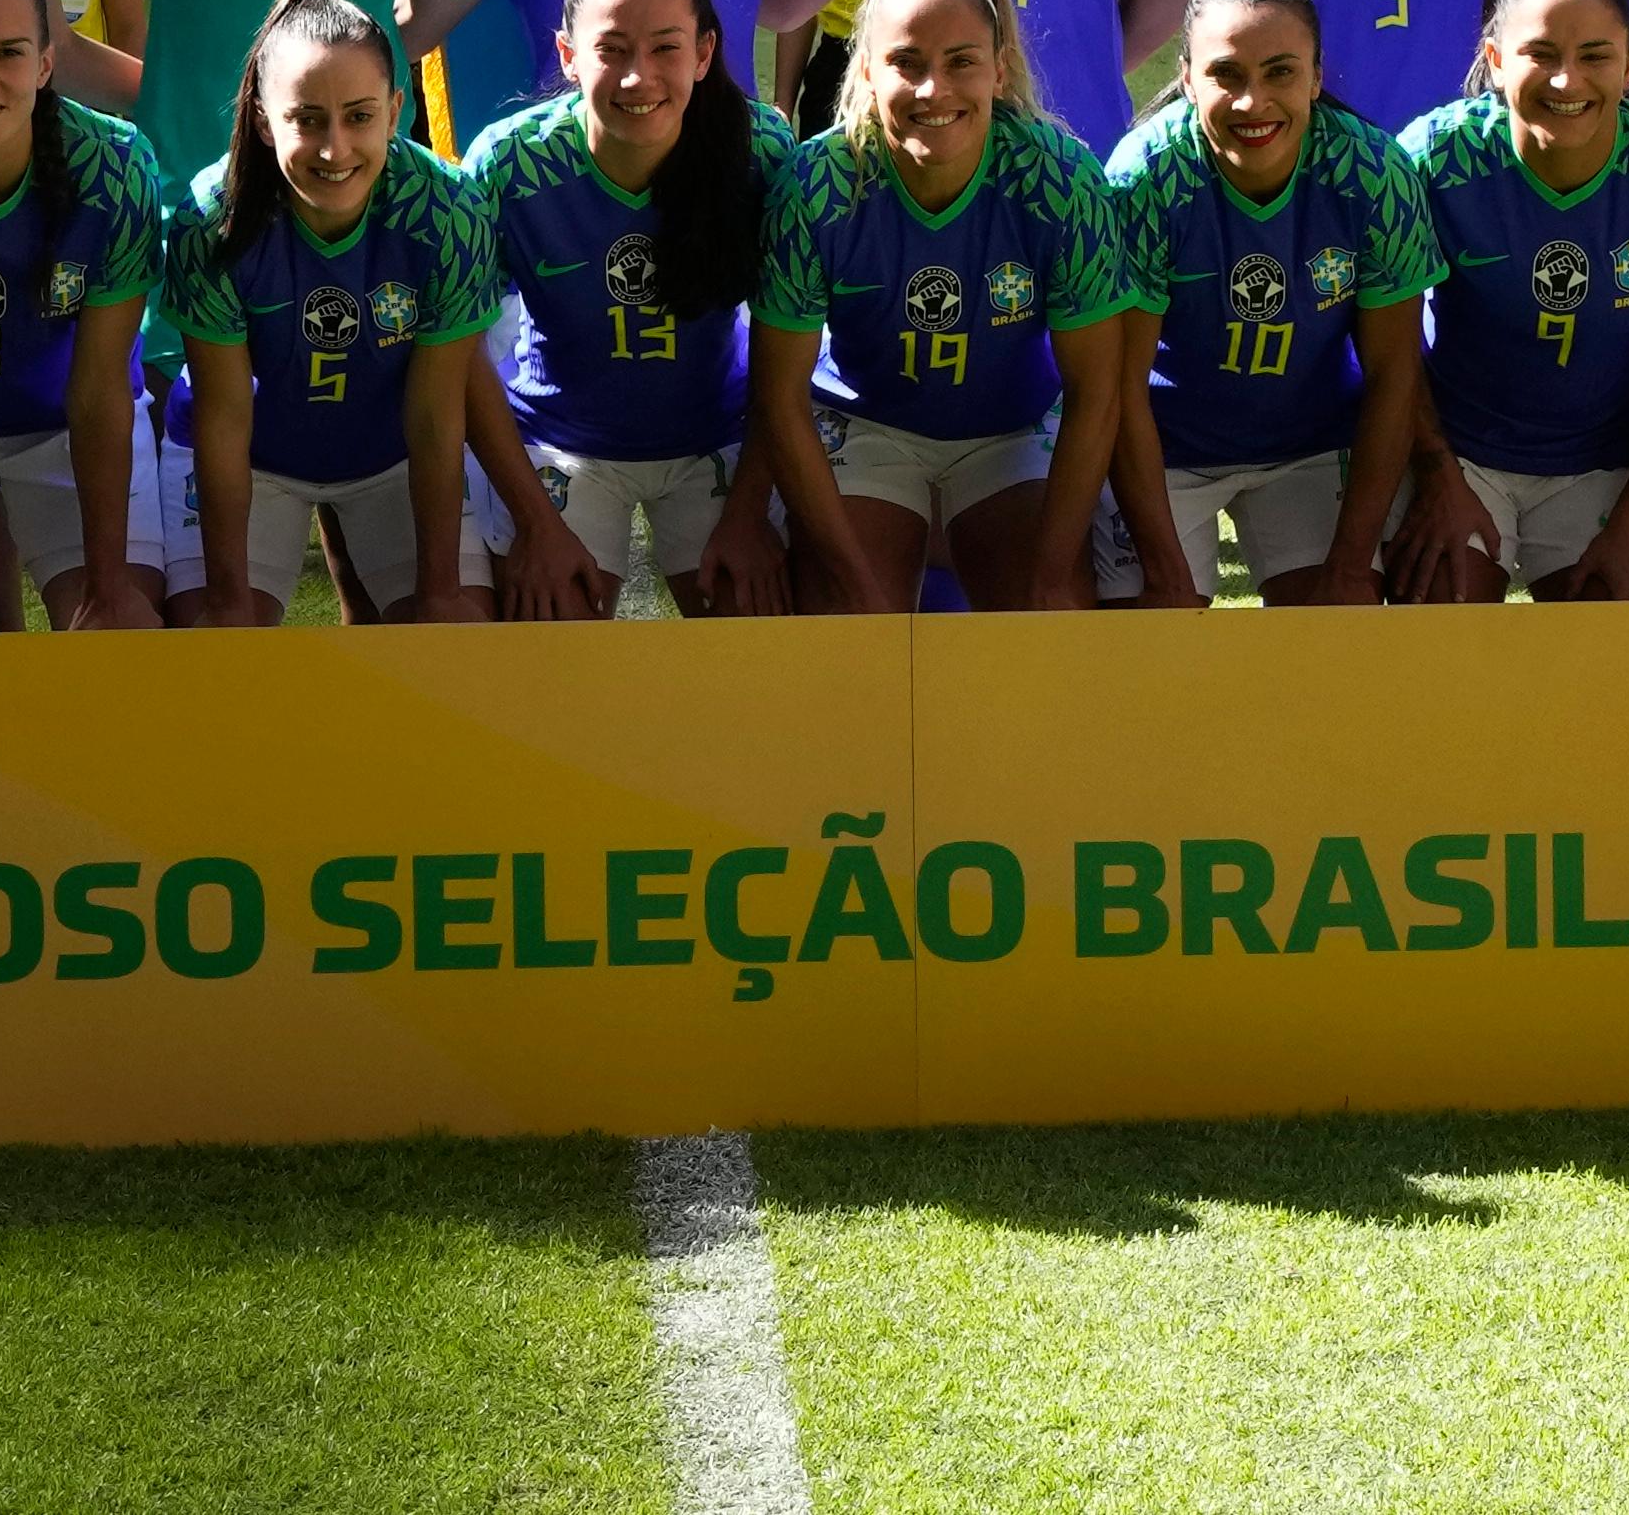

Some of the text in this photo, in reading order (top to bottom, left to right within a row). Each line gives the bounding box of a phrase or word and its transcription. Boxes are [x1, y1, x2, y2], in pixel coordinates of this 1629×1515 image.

[990, 308, 1036, 327] BRASIL
[1316, 289, 1357, 312] BRASIL
[606, 303, 676, 362] 13
[898, 329, 968, 386] 19
[1218, 321, 1294, 376] 10
[1537, 311, 1576, 368] 9
[307, 352, 348, 403] 5
[312, 814, 1025, 1000] SELEÇÃO
